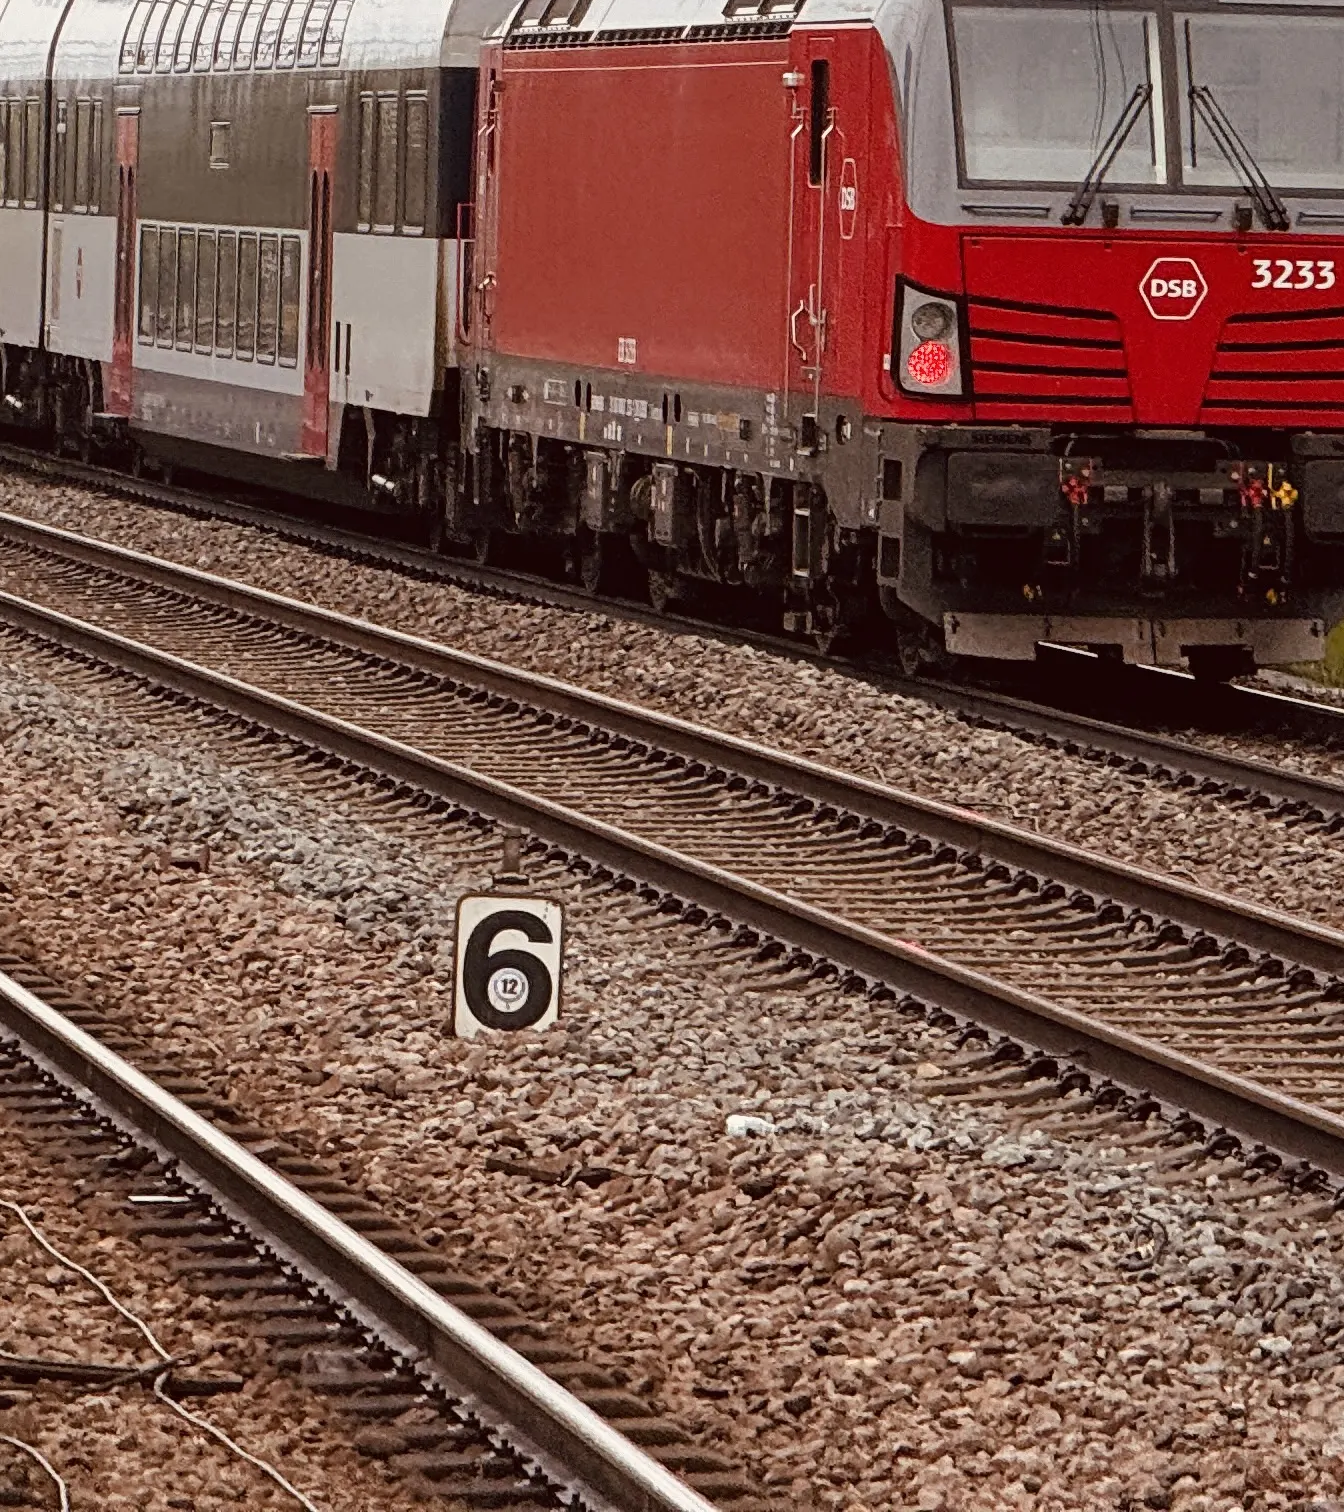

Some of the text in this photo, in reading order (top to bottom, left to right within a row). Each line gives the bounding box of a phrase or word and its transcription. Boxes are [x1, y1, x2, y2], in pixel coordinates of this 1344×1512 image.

[841, 186, 856, 211] DSB
[1251, 259, 1337, 291] 3233
[1150, 278, 1197, 299] DSB
[462, 909, 554, 1032] 6
[500, 978, 519, 995] 12
